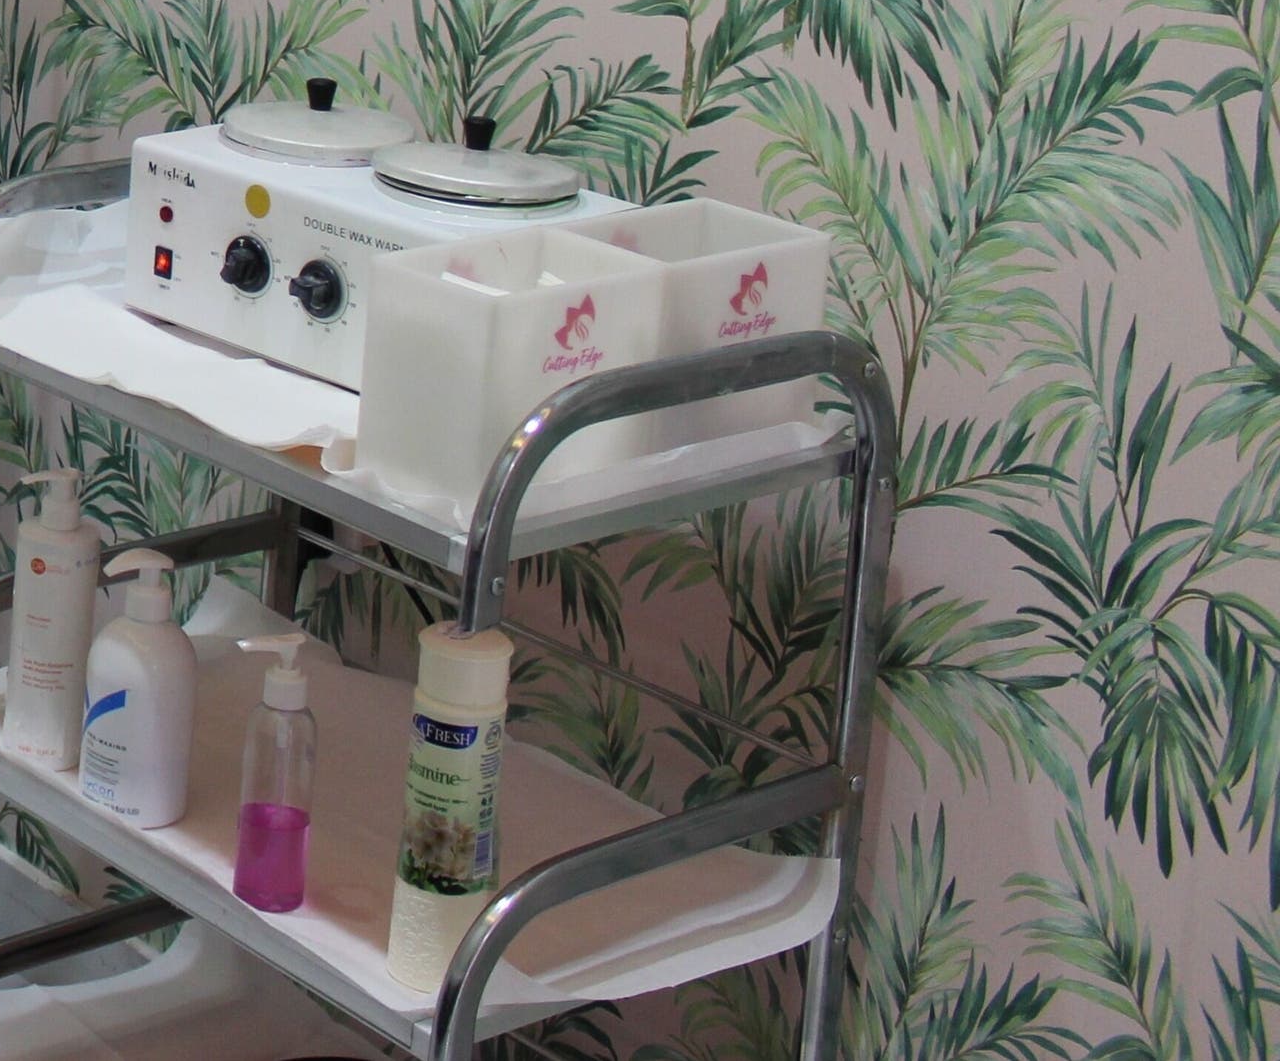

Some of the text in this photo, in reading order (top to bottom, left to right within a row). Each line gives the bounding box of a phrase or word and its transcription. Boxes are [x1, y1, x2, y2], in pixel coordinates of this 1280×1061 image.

[148, 161, 196, 188] Mishida
[303, 216, 405, 253] DOUBLE WAX WAR
[718, 311, 777, 339] Cutting Edge
[542, 345, 604, 374] Cutting Edge
